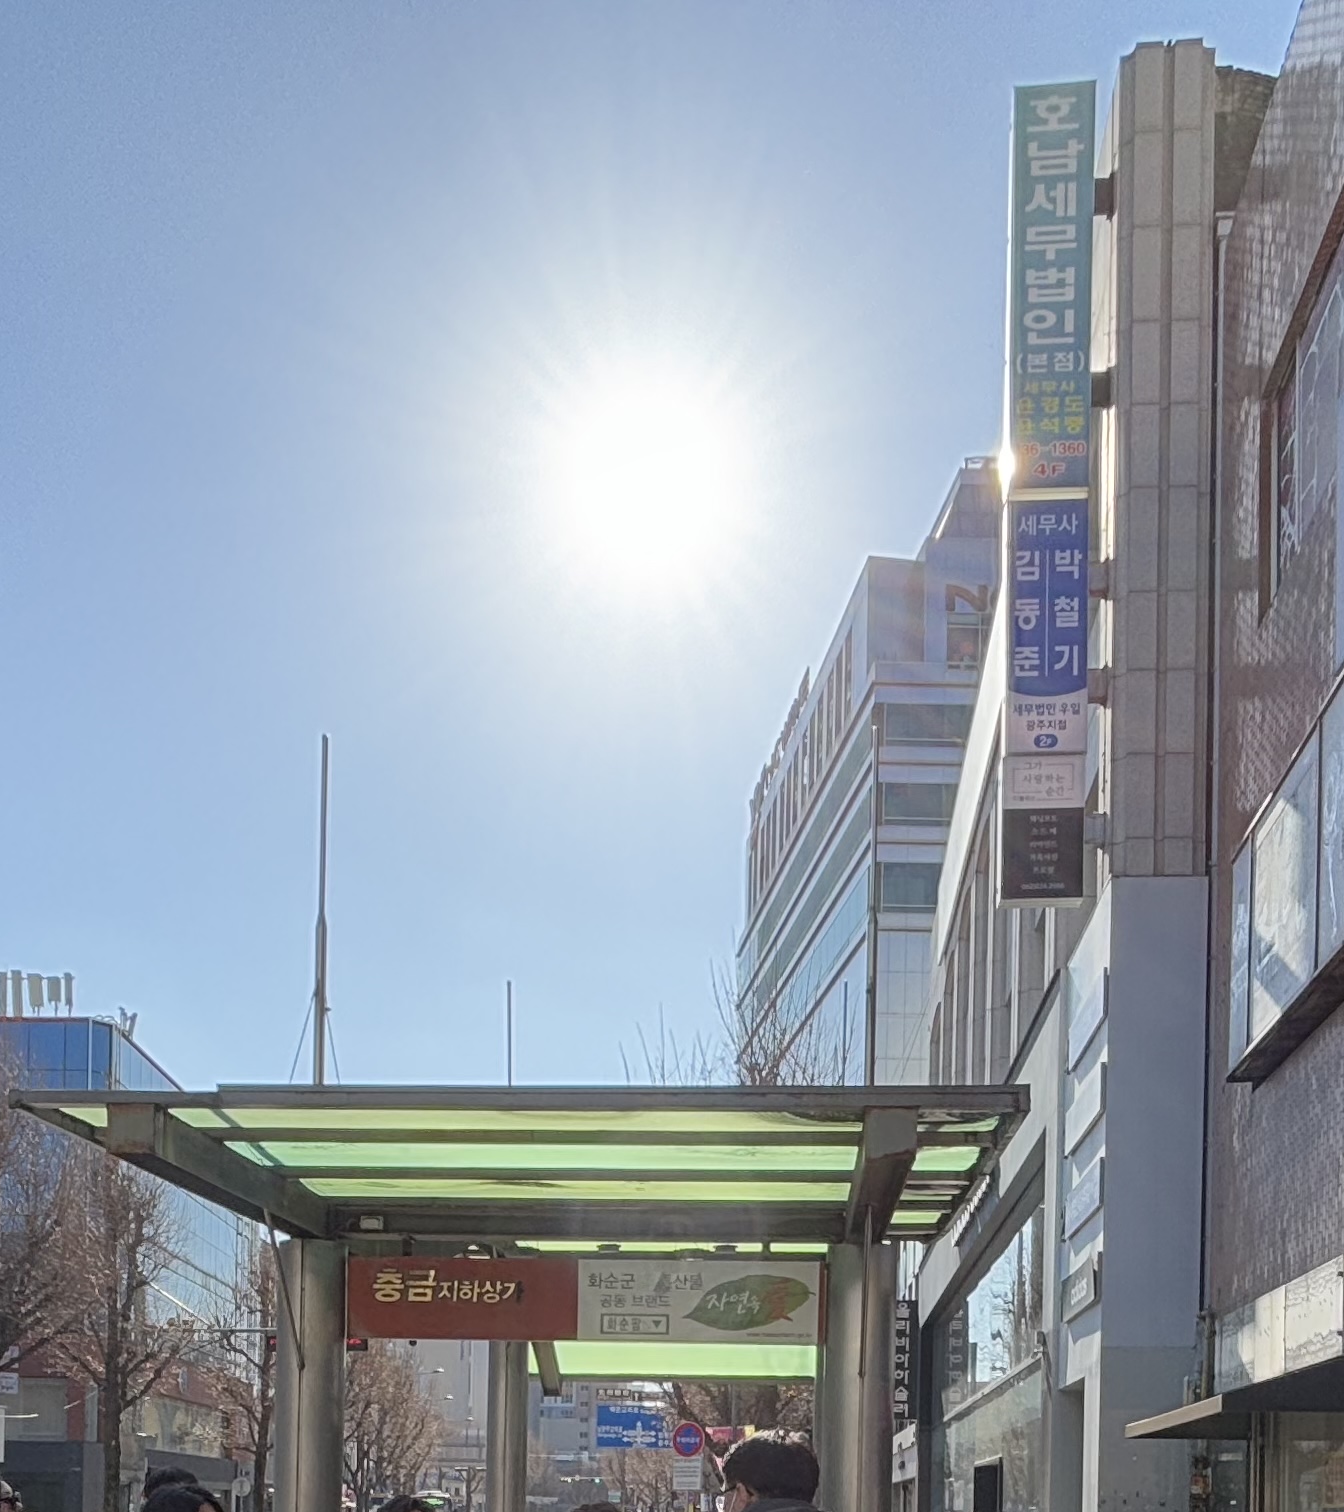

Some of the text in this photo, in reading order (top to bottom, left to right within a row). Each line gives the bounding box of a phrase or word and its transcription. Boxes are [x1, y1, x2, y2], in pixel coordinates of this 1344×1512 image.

[1023, 95, 1085, 345] 호남세무법인
[1017, 351, 1084, 374] (본점)
[1024, 381, 1075, 394] 세무사
[1020, 440, 1087, 457] 36-1360
[1032, 462, 1066, 477] 4F
[1018, 513, 1078, 536] 세무사
[1014, 550, 1040, 677] 김동준
[1054, 549, 1082, 676] 박철기
[1013, 702, 1081, 718] 세무법인 우일
[1026, 719, 1067, 731] 광주지점
[1023, 774, 1066, 784] 사랑하는
[588, 1274, 636, 1289] 화순군
[600, 1294, 671, 1309] 공동 브랜드
